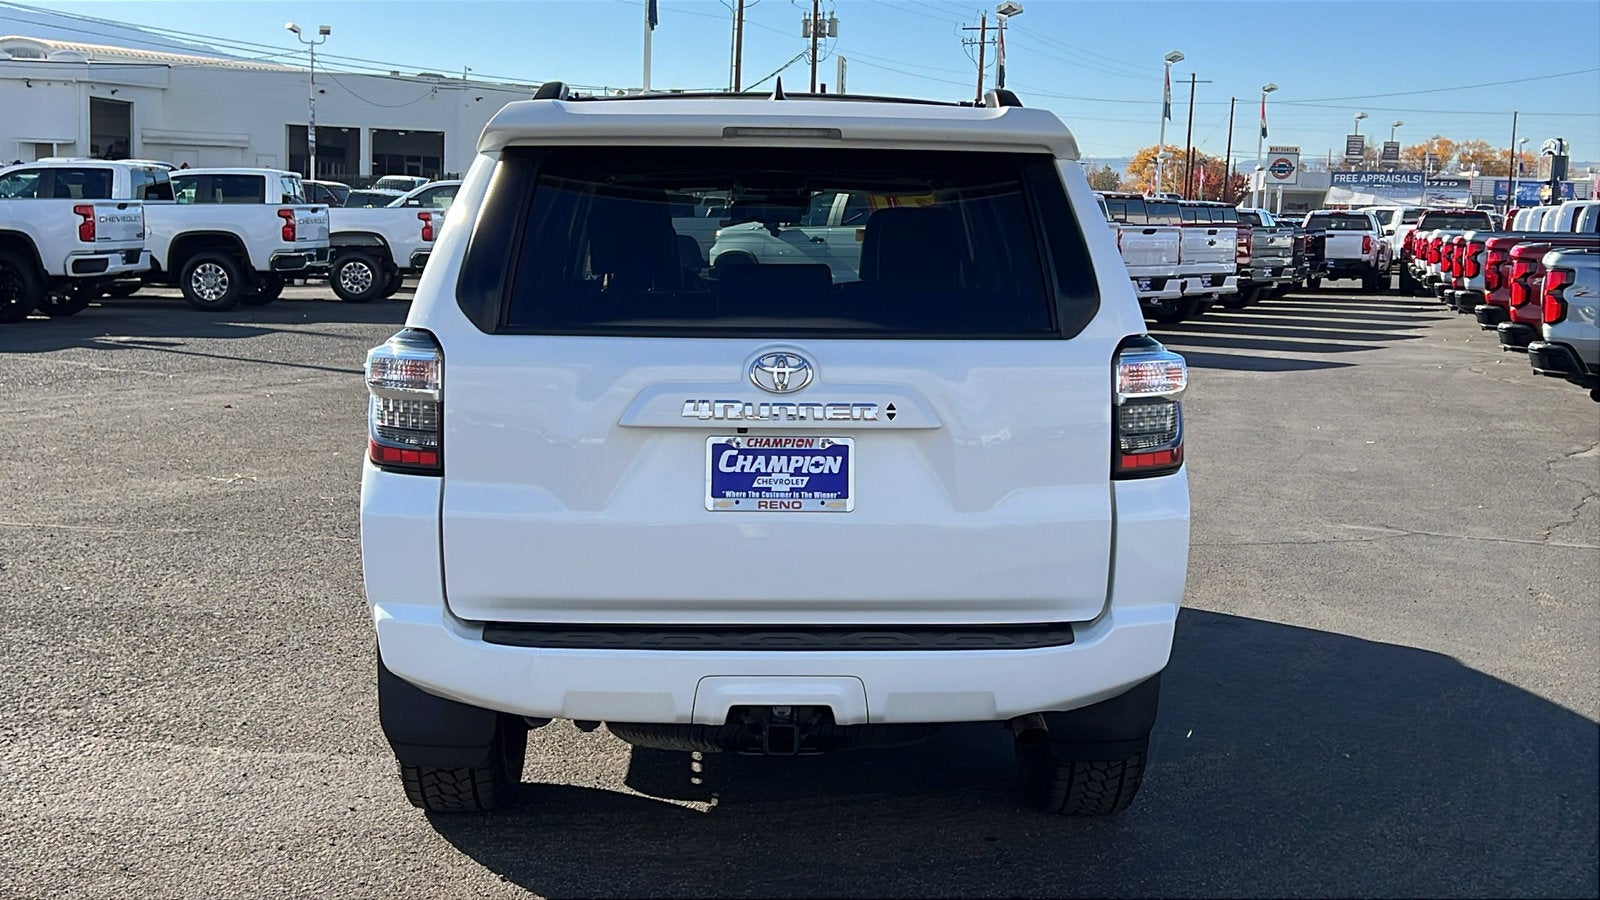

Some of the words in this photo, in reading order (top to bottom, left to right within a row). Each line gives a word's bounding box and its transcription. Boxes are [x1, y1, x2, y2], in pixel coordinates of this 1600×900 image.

[1333, 174, 1359, 183] FREE
[1360, 174, 1422, 184] APPRAISALS!
[746, 438, 814, 448] CHAMPION
[756, 478, 804, 486] CHEVROLET
[748, 490, 760, 499] The
[761, 490, 792, 499] Customer
[801, 491, 812, 499] The
[757, 501, 802, 510] RENO
